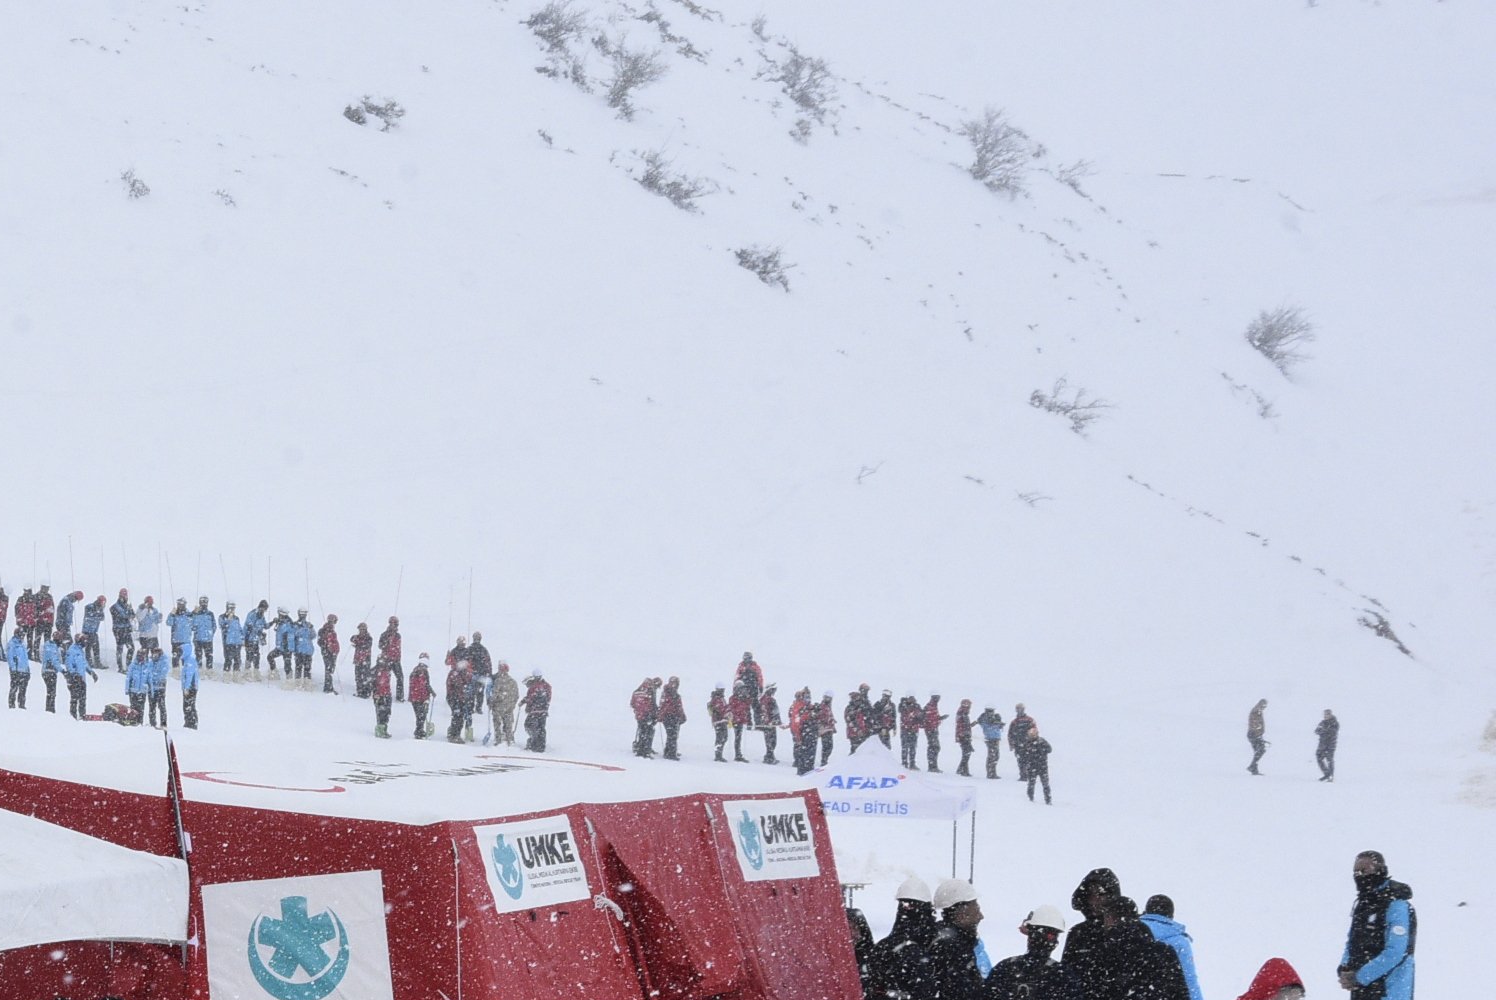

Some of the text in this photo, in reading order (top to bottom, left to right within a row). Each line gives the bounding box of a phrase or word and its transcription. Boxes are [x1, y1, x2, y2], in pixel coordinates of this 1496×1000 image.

[826, 775, 899, 790] AFAD
[822, 801, 851, 814] FAD
[864, 801, 909, 815] BİTLİS
[760, 812, 809, 845] UMKE
[517, 831, 576, 869] UMKE
